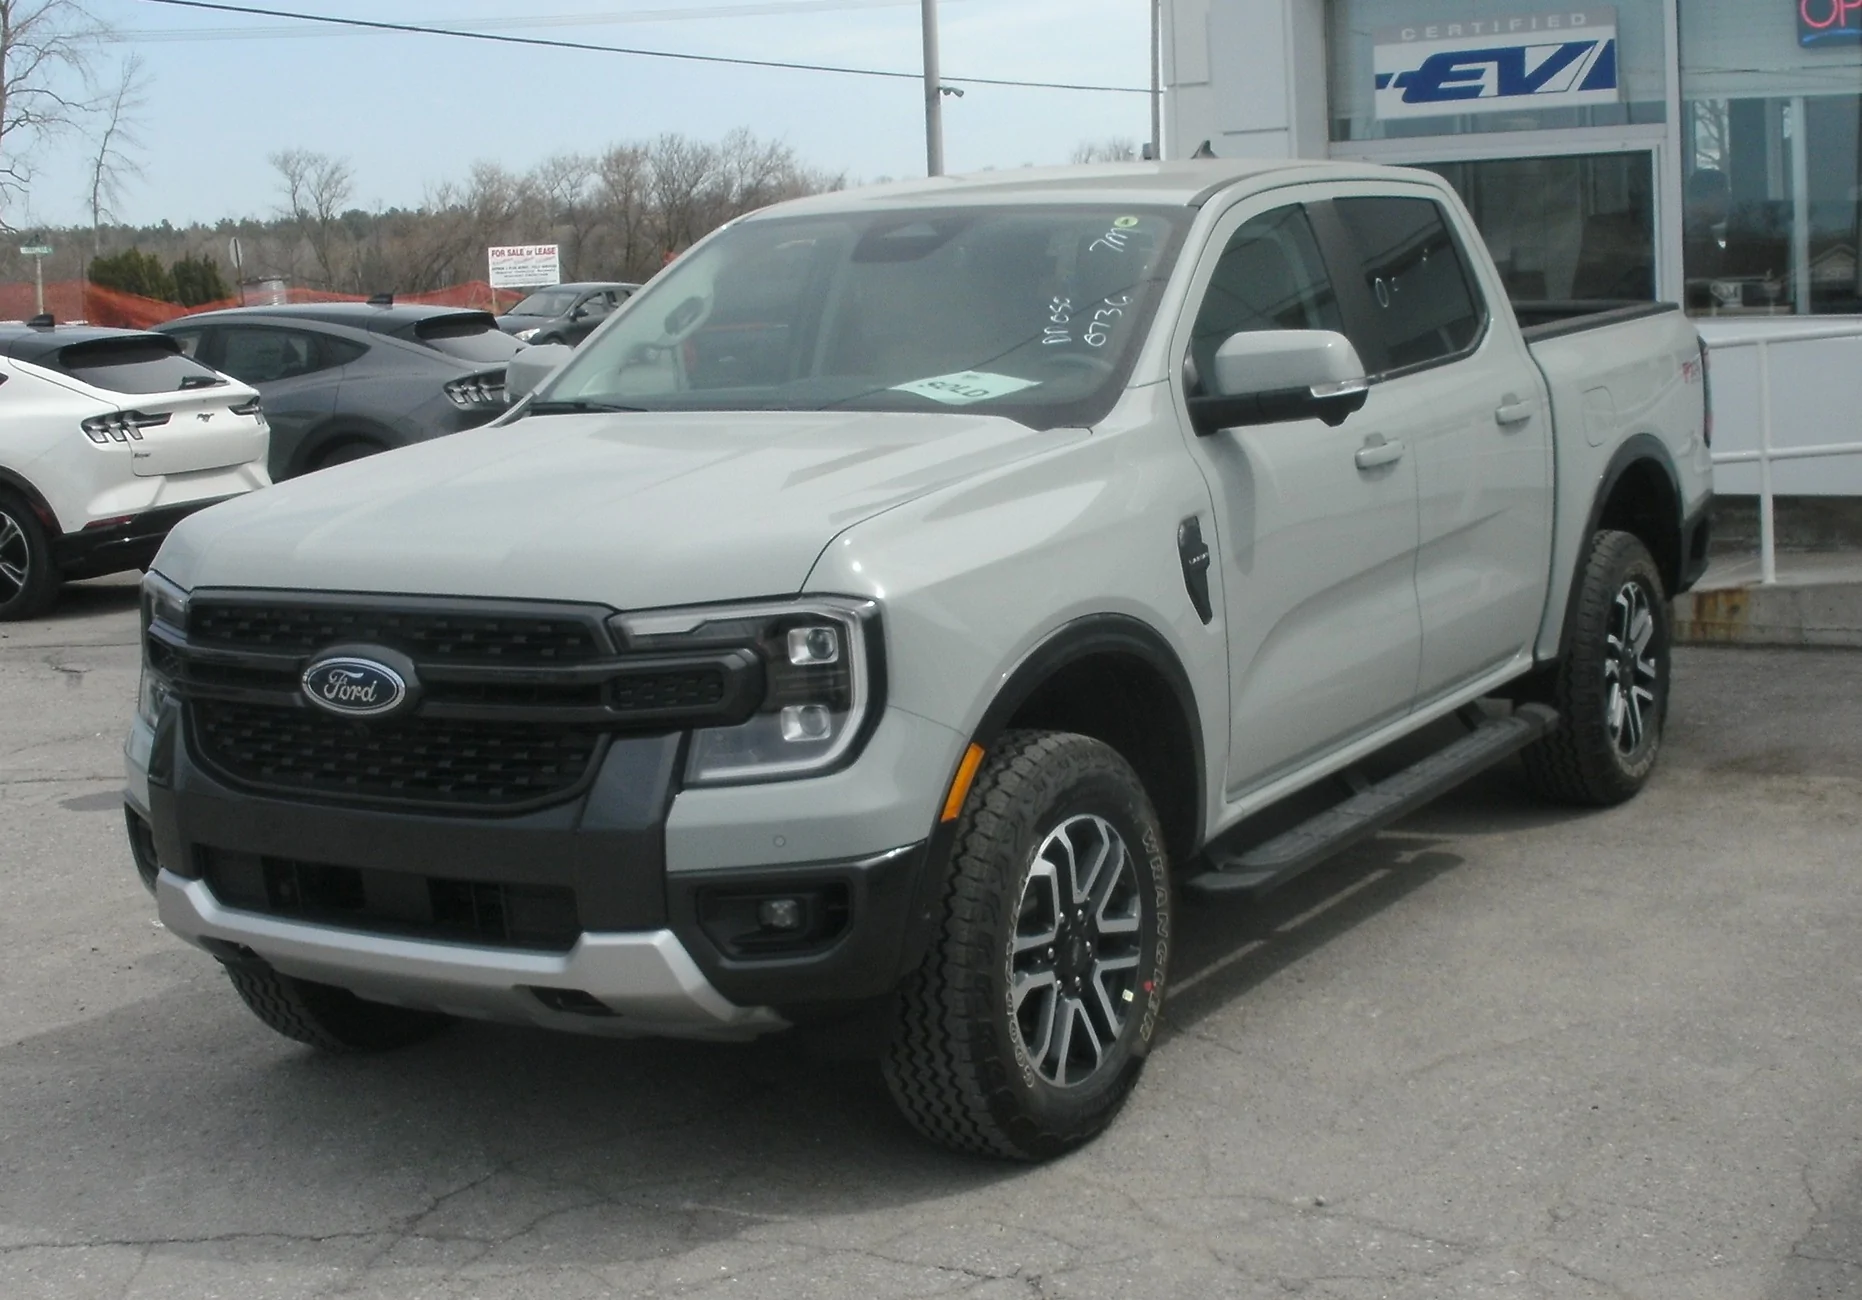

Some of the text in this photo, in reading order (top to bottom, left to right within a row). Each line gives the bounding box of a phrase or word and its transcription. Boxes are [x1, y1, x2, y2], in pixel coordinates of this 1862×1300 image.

[1401, 12, 1587, 41] CERTIFIED
[491, 249, 506, 258] FOR
[507, 248, 525, 257] SALE
[534, 246, 557, 256] LEASE
[323, 669, 378, 702] Ford
[1142, 826, 1168, 1042] WRANGLER
